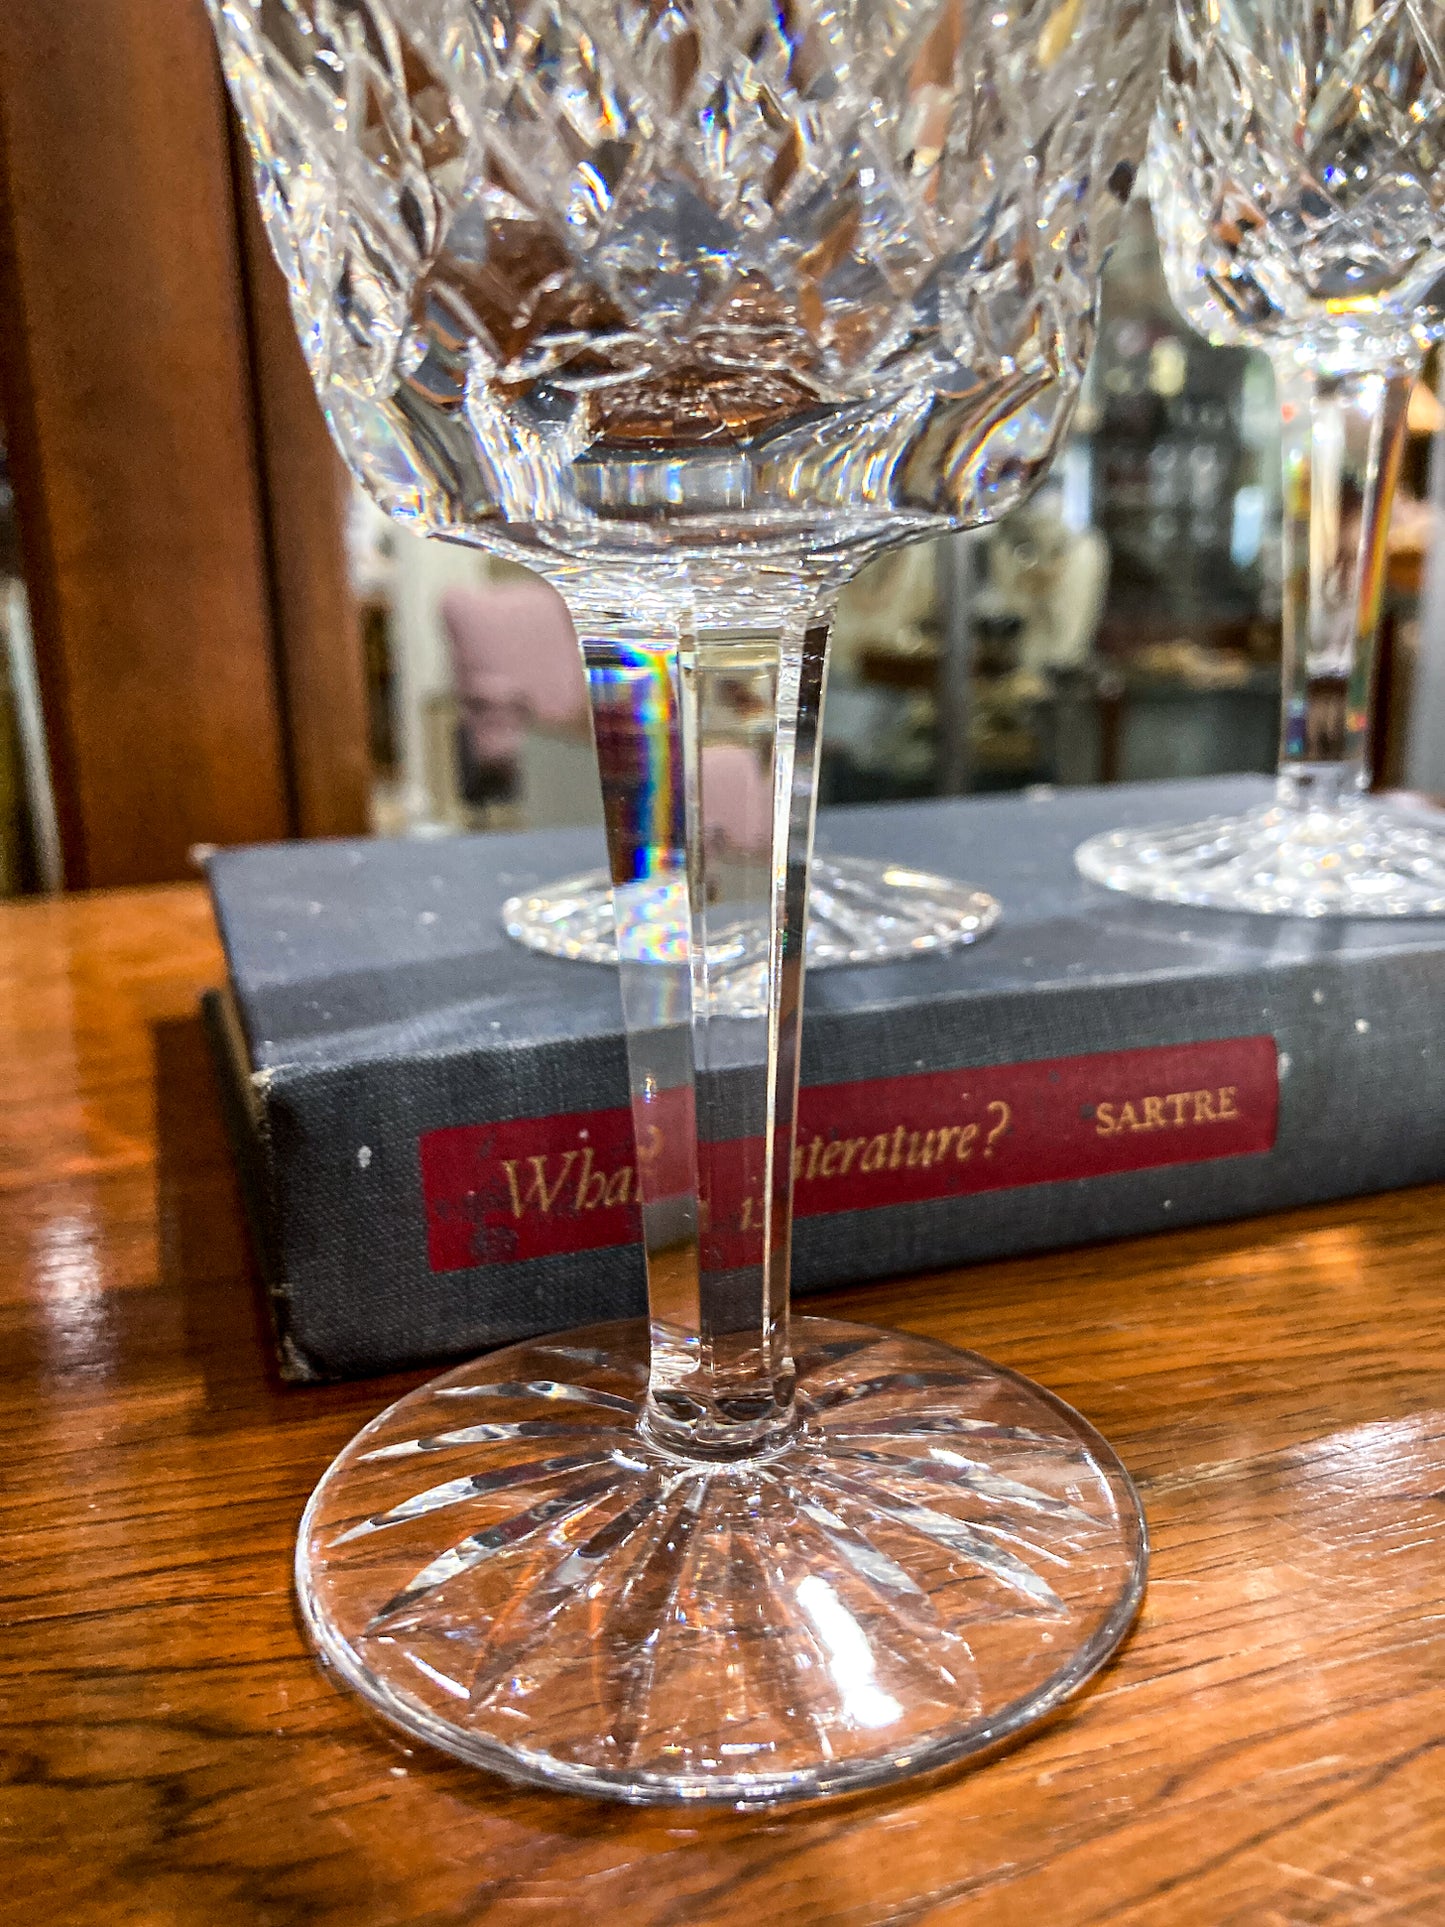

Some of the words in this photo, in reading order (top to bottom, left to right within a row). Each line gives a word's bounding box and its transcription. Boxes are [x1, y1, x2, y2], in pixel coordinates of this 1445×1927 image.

[1096, 1086, 1238, 1136] SARTRE
[502, 1147, 643, 1219] Wha
[793, 1100, 1011, 1181] iterature?
